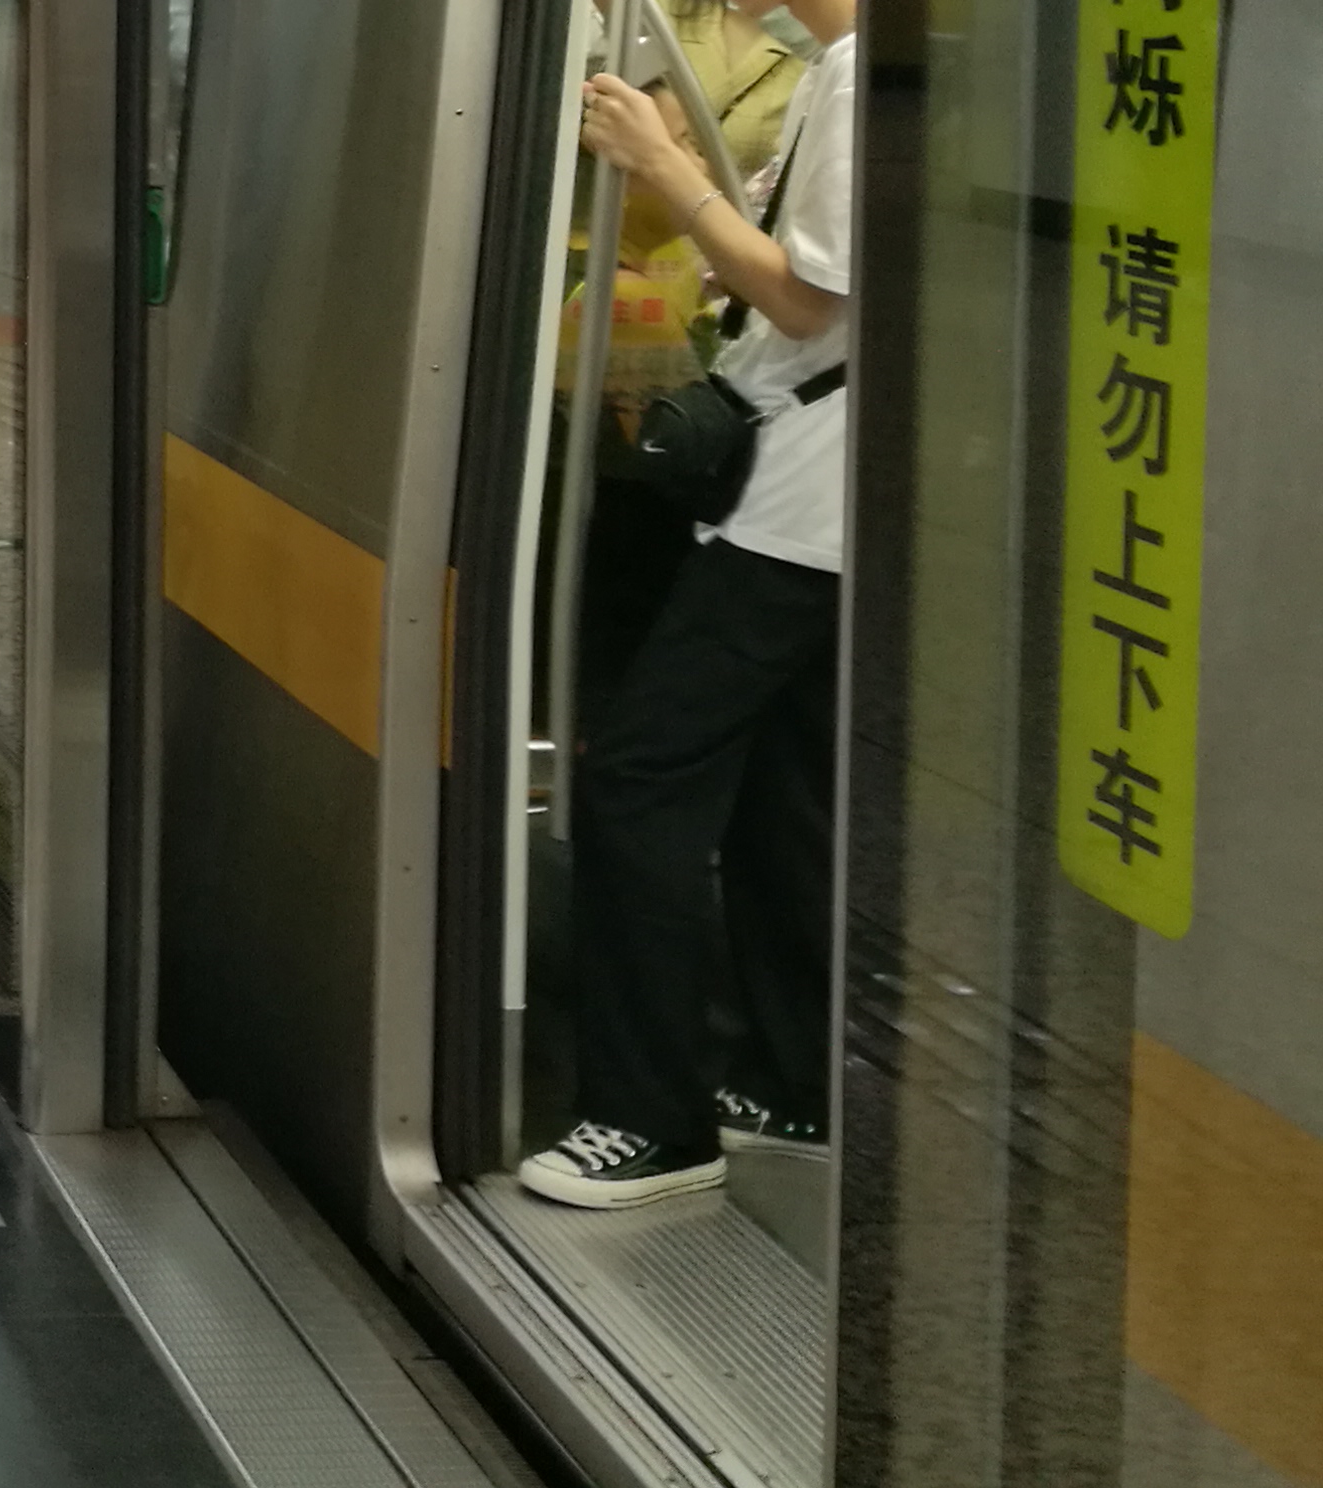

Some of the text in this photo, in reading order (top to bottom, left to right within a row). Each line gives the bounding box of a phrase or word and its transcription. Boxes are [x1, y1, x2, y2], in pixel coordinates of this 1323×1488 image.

[1087, 224, 1181, 866] 请勿上下车
